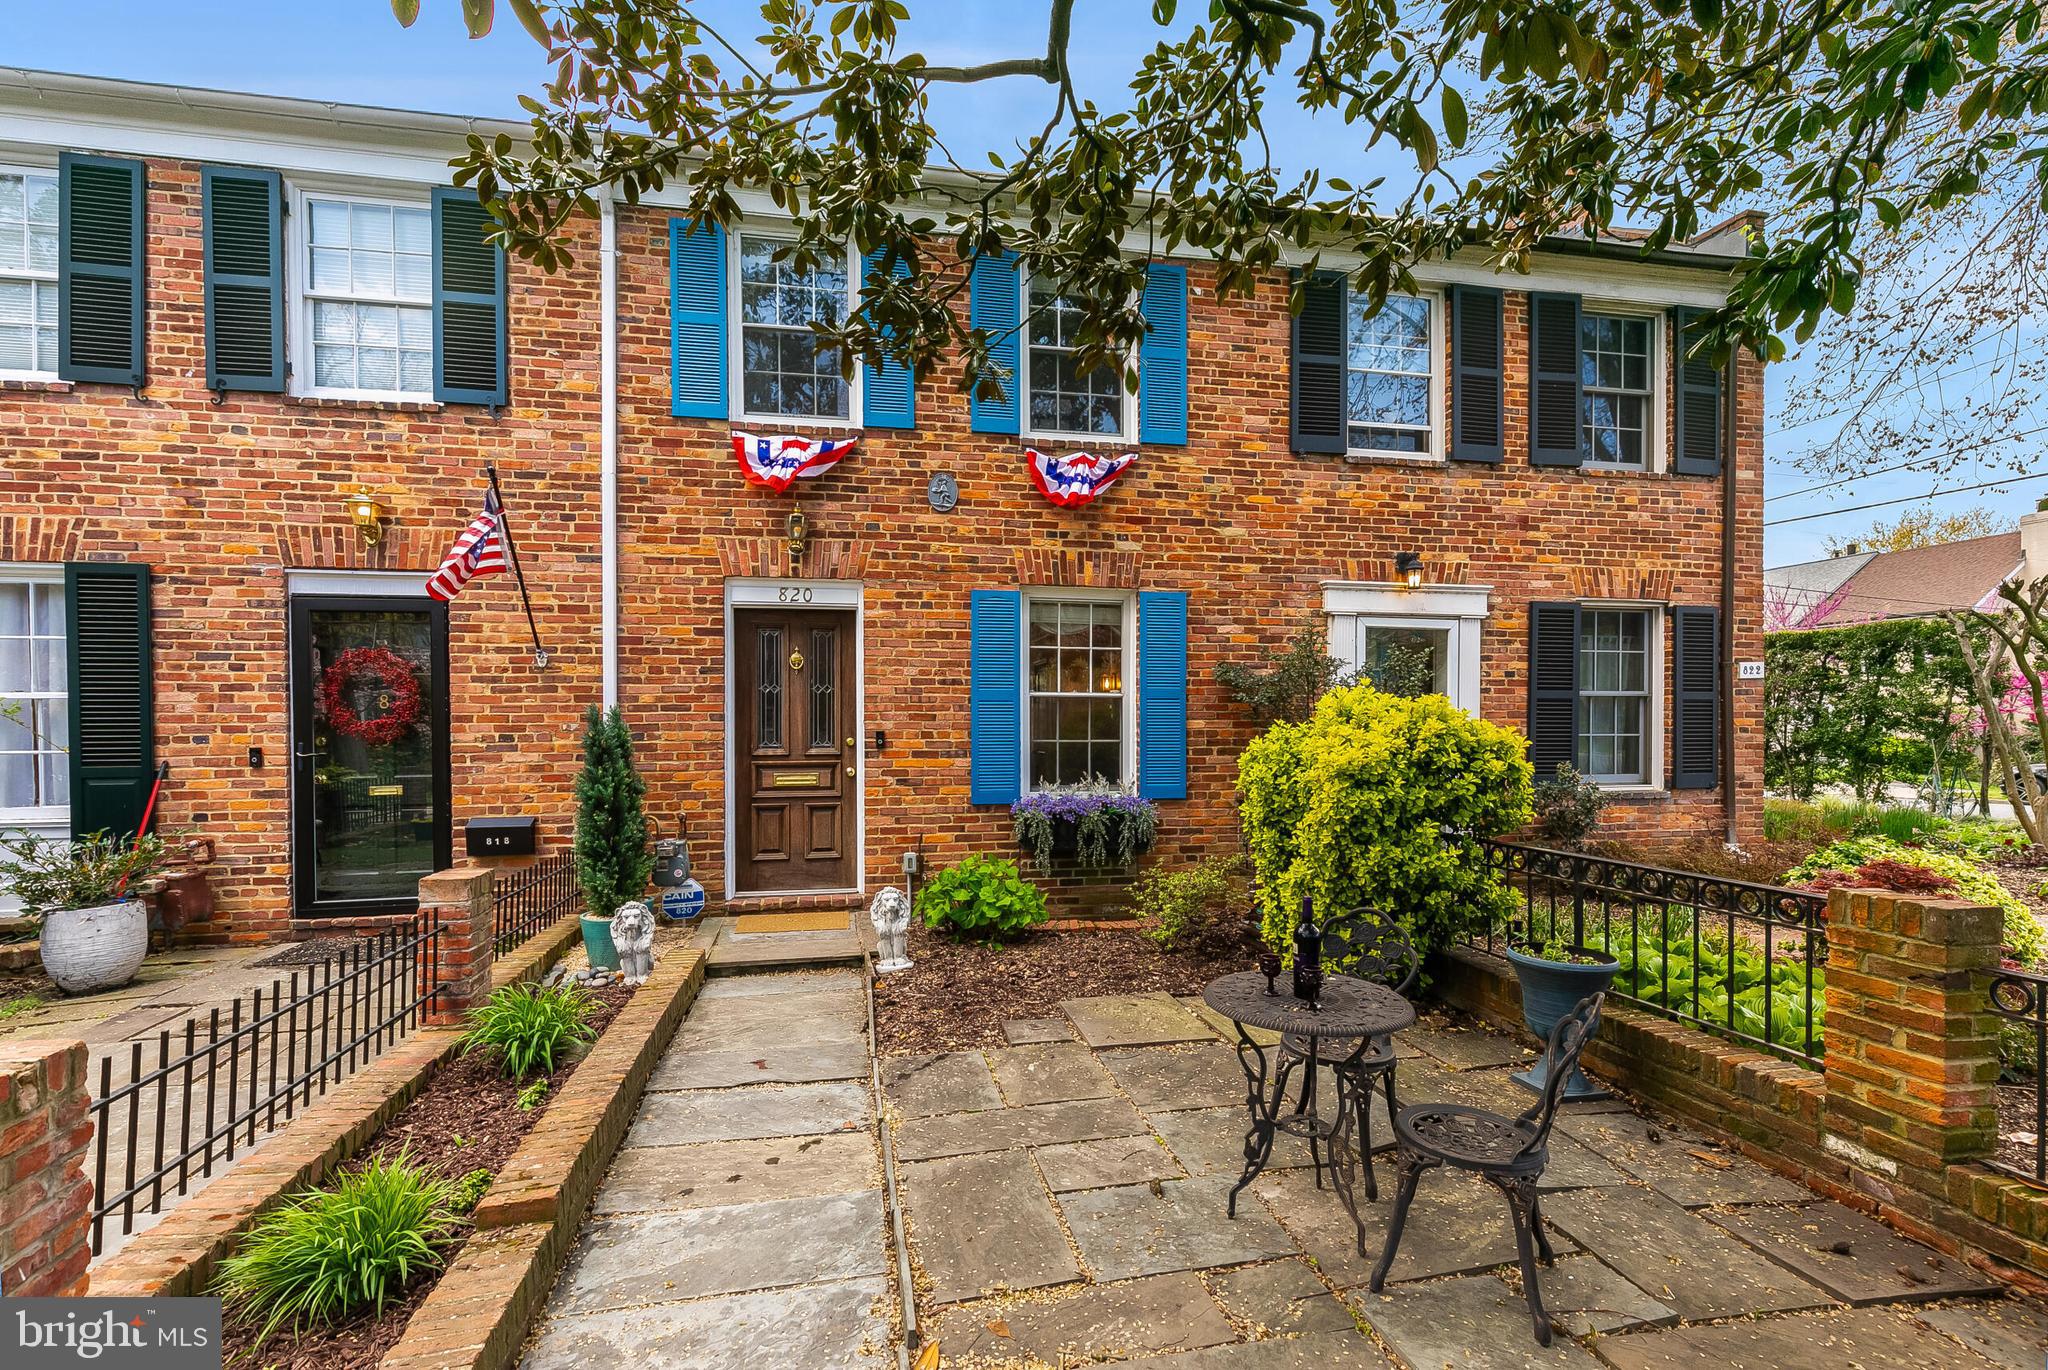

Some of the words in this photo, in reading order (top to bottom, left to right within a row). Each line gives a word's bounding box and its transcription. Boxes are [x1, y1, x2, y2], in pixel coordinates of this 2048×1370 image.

[779, 587, 813, 603] 820
[1743, 665, 1761, 675] 822
[486, 837, 510, 846] 818
[663, 892, 694, 901] CAIN
[676, 907, 693, 915] 820
